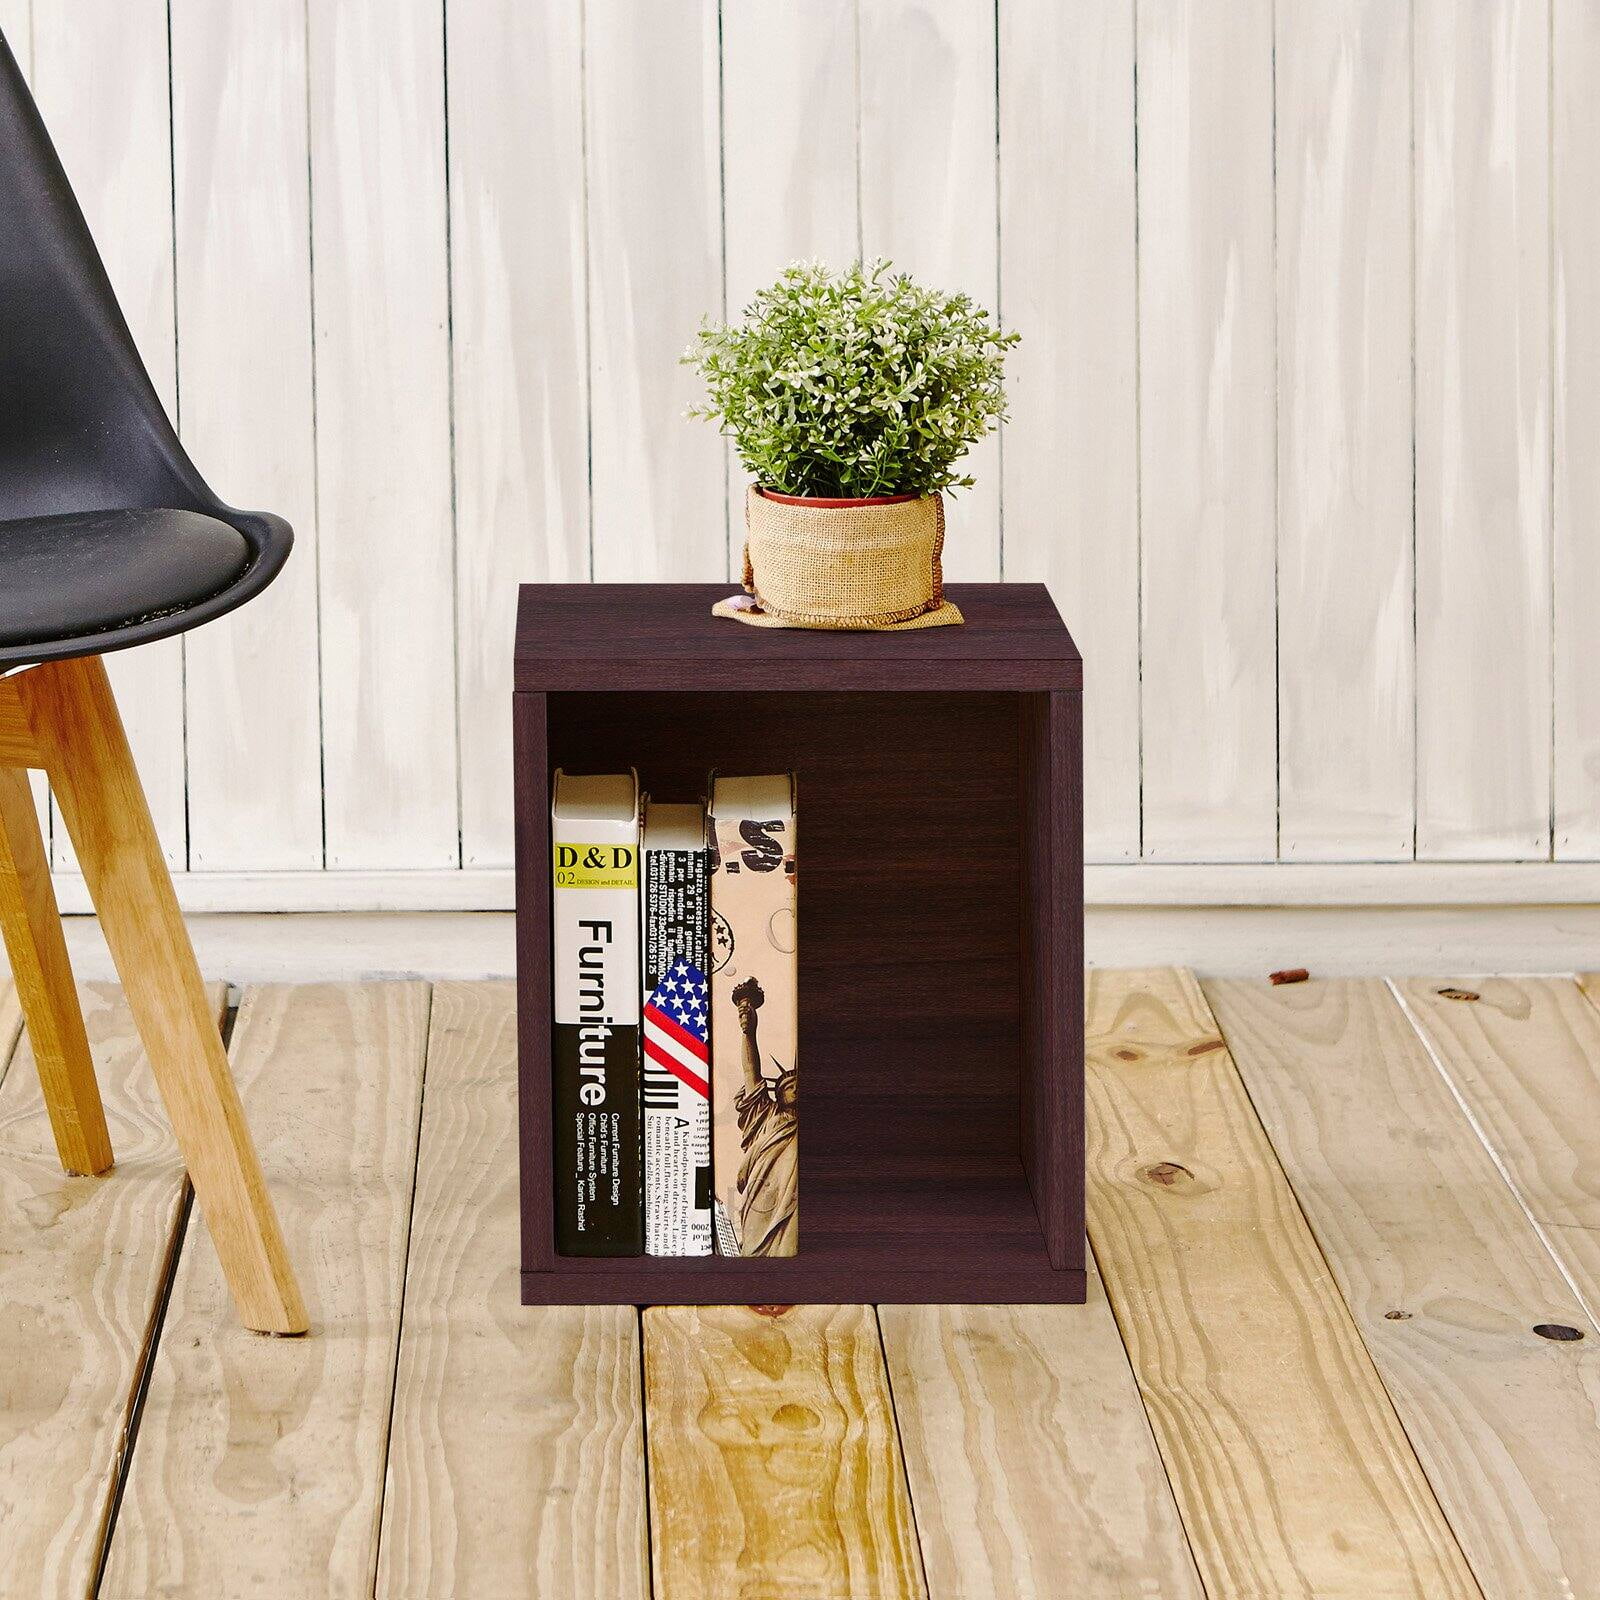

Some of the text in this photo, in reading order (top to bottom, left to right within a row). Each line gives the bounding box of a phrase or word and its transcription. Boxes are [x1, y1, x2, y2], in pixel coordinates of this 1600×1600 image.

[557, 846, 632, 868] D & D
[667, 852, 677, 883] gennaio
[676, 868, 684, 882] per
[658, 884, 668, 915] STUDIO
[686, 884, 695, 895] 29
[666, 889, 677, 922] rispedire
[677, 888, 686, 920] vendere
[686, 901, 695, 909] al
[686, 914, 695, 924] 31
[675, 926, 685, 955] meglio
[578, 919, 613, 1106] Furniture
[576, 1112, 585, 1140] Special
[664, 1116, 672, 1151] beneath
[673, 1130, 681, 1147] and
[577, 1142, 585, 1171] Feature
[587, 1112, 597, 1201] Office Furniture System
[600, 1112, 609, 1174] Child's Furniture
[610, 1112, 621, 1206] Current Furniture Design
[674, 1117, 690, 1129] A
[682, 1195, 688, 1204] of
[577, 1180, 586, 1202] Karim
[672, 1179, 678, 1189] on
[577, 1204, 586, 1231] Rashid
[663, 1206, 671, 1231] skirts
[691, 1223, 711, 1231] 2000
